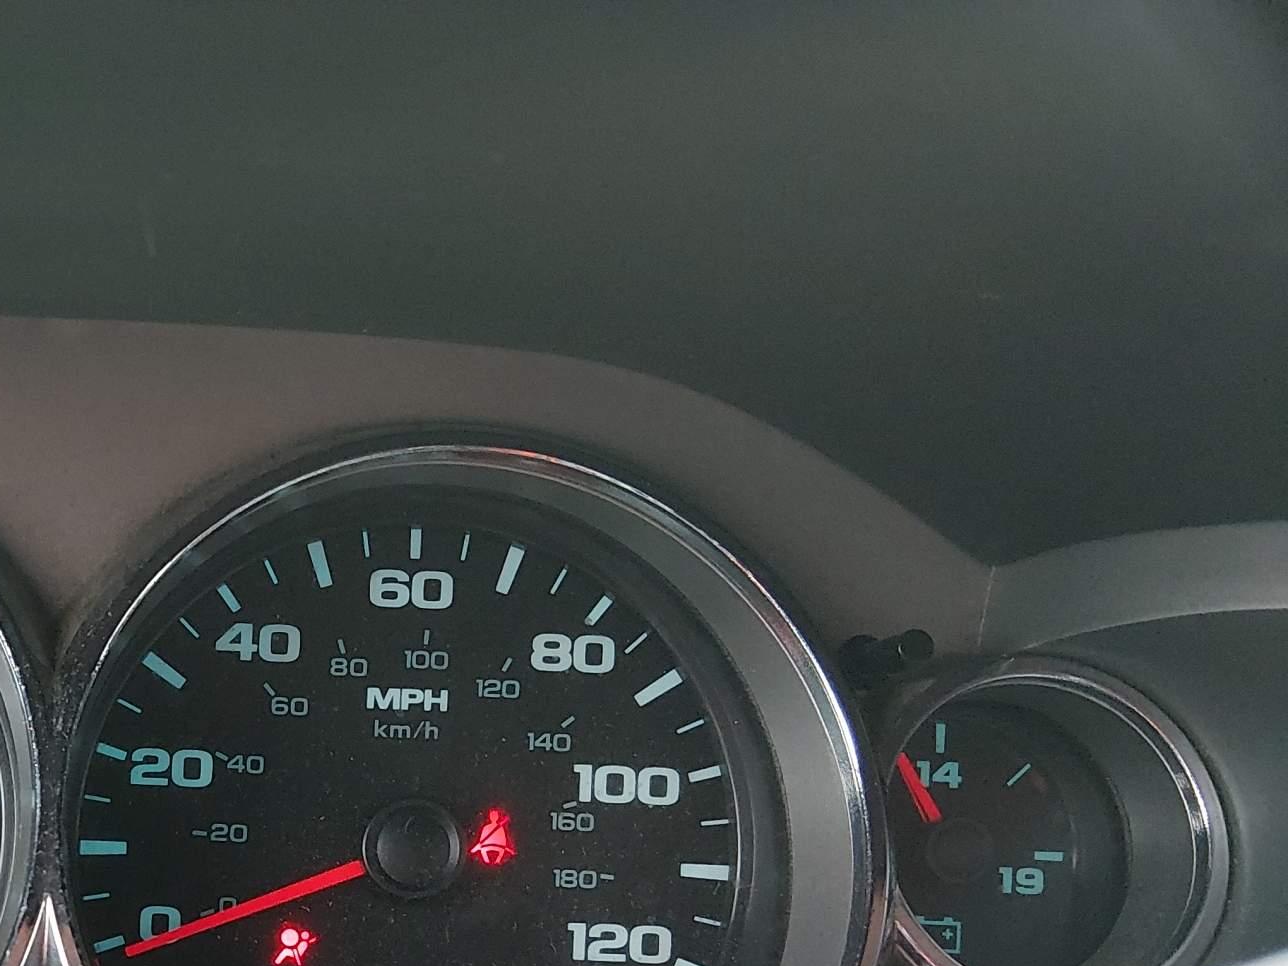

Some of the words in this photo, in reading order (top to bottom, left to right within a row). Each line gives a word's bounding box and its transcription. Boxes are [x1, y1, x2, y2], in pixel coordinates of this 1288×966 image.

[368, 568, 455, 611] 60
[215, 622, 301, 663] 40
[530, 632, 615, 675] 80
[329, 656, 368, 677] 80
[403, 647, 450, 670] 100
[365, 687, 449, 713] MPH
[475, 678, 521, 700] 120
[270, 696, 310, 717] 60
[373, 719, 441, 740] km/h
[527, 732, 572, 753] 140
[129, 747, 214, 788] 20
[226, 754, 266, 775] 40
[916, 760, 962, 789] 14
[573, 763, 680, 806] 100
[209, 823, 249, 844] 20
[550, 811, 595, 833] 160
[552, 869, 598, 890] 180
[998, 867, 1045, 896] 19
[139, 905, 182, 943] 0
[567, 922, 673, 965] 120
